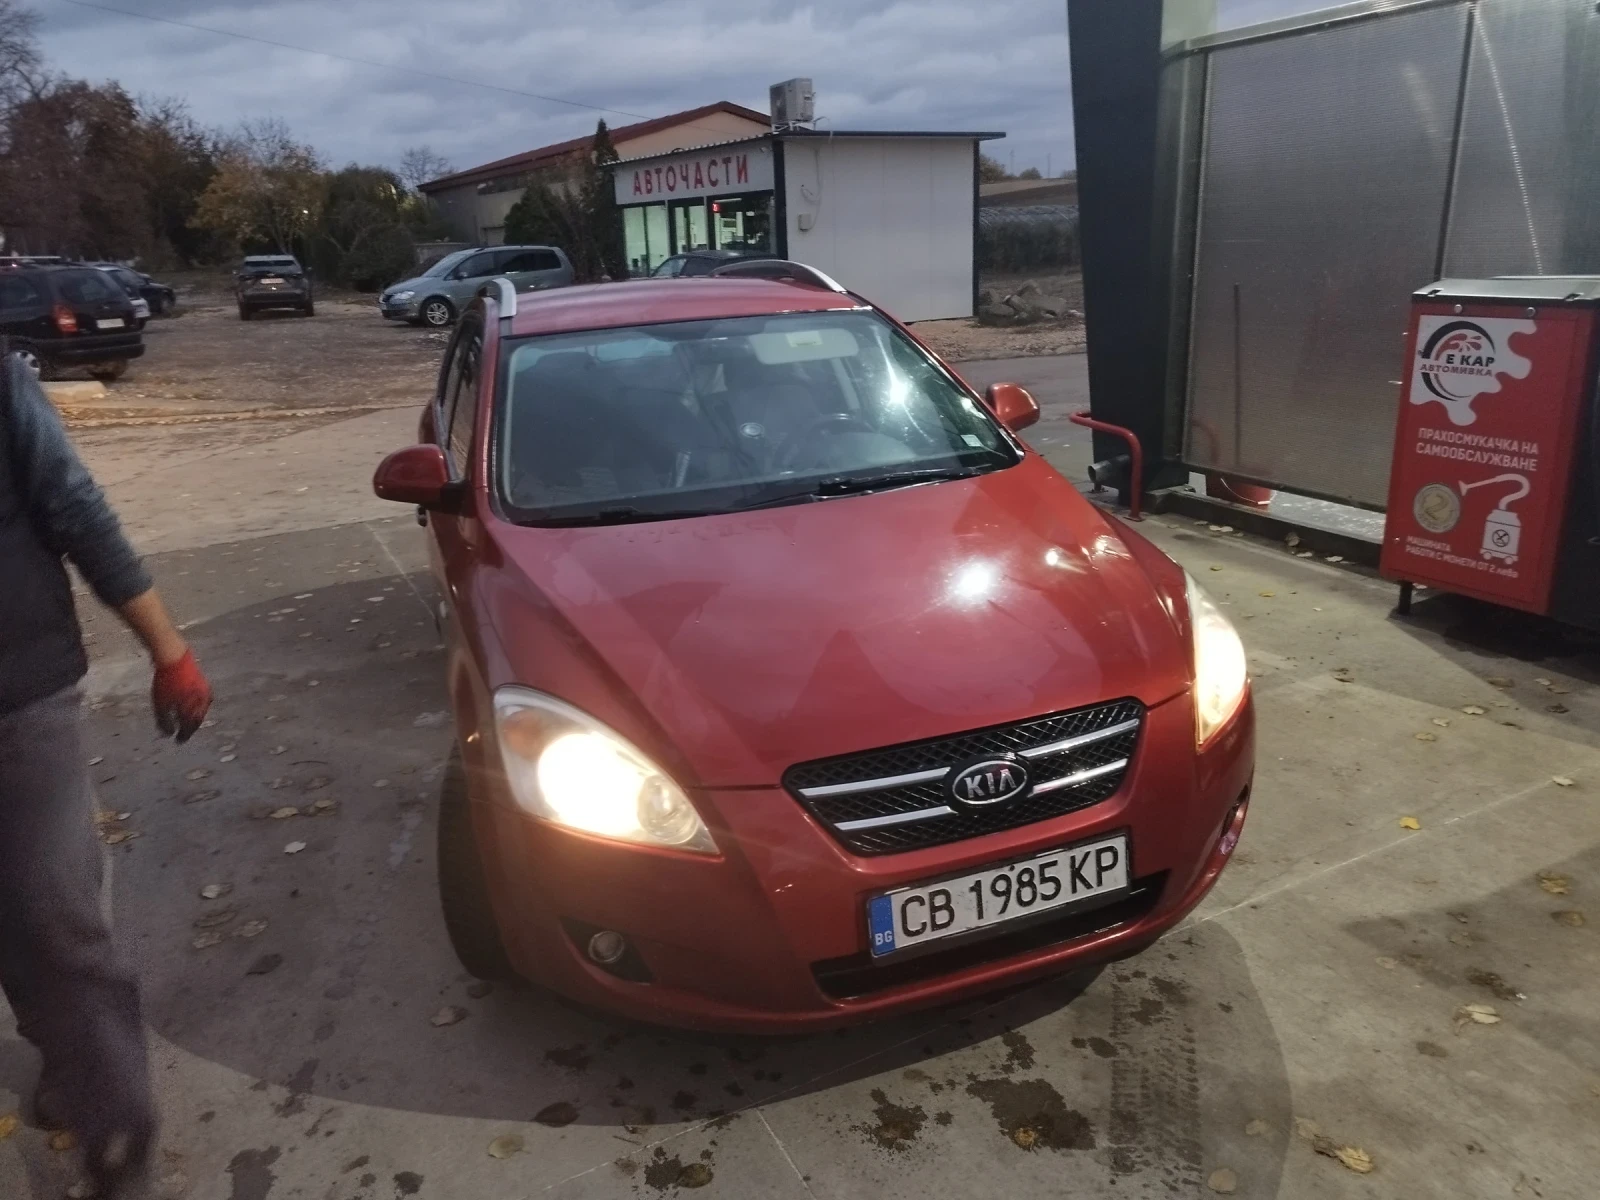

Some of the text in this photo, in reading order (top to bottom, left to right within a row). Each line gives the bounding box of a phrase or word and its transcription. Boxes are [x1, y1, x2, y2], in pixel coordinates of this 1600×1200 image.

[633, 154, 748, 196] АВТОЧАСТИ
[1420, 364, 1493, 377] АВТОМИВКА
[1460, 355, 1495, 367] КАР
[1418, 427, 1539, 455] ПРАХОСМУКАЧКА НА
[1416, 442, 1539, 471] САМООБСЛУЖВАНЕ
[1489, 564, 1496, 573] 2
[963, 768, 1017, 798] KIA
[901, 845, 1119, 938] CB 1985 KP
[875, 929, 893, 946] BG
